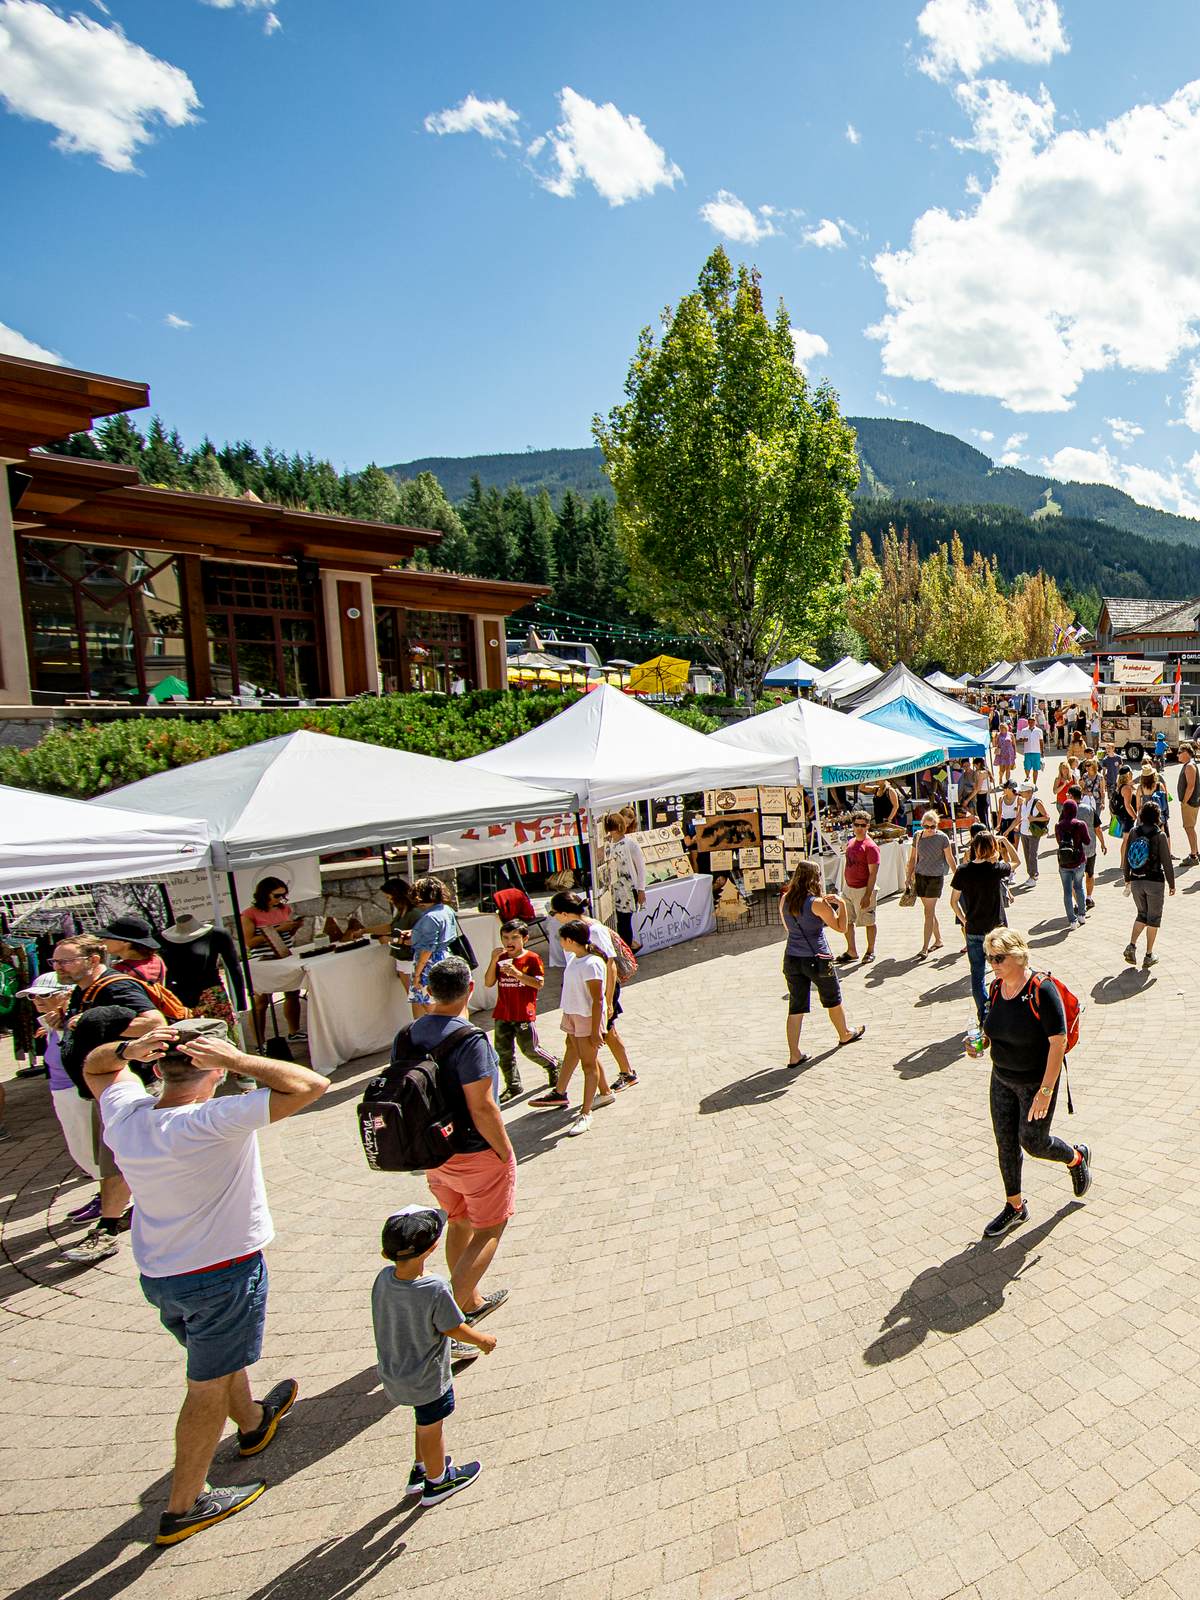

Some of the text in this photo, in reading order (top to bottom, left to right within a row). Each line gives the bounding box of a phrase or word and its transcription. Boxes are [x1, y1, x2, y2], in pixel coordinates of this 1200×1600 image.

[827, 767, 874, 783] Massage
[639, 926, 665, 944] PINE
[667, 914, 704, 936] PRINTS
